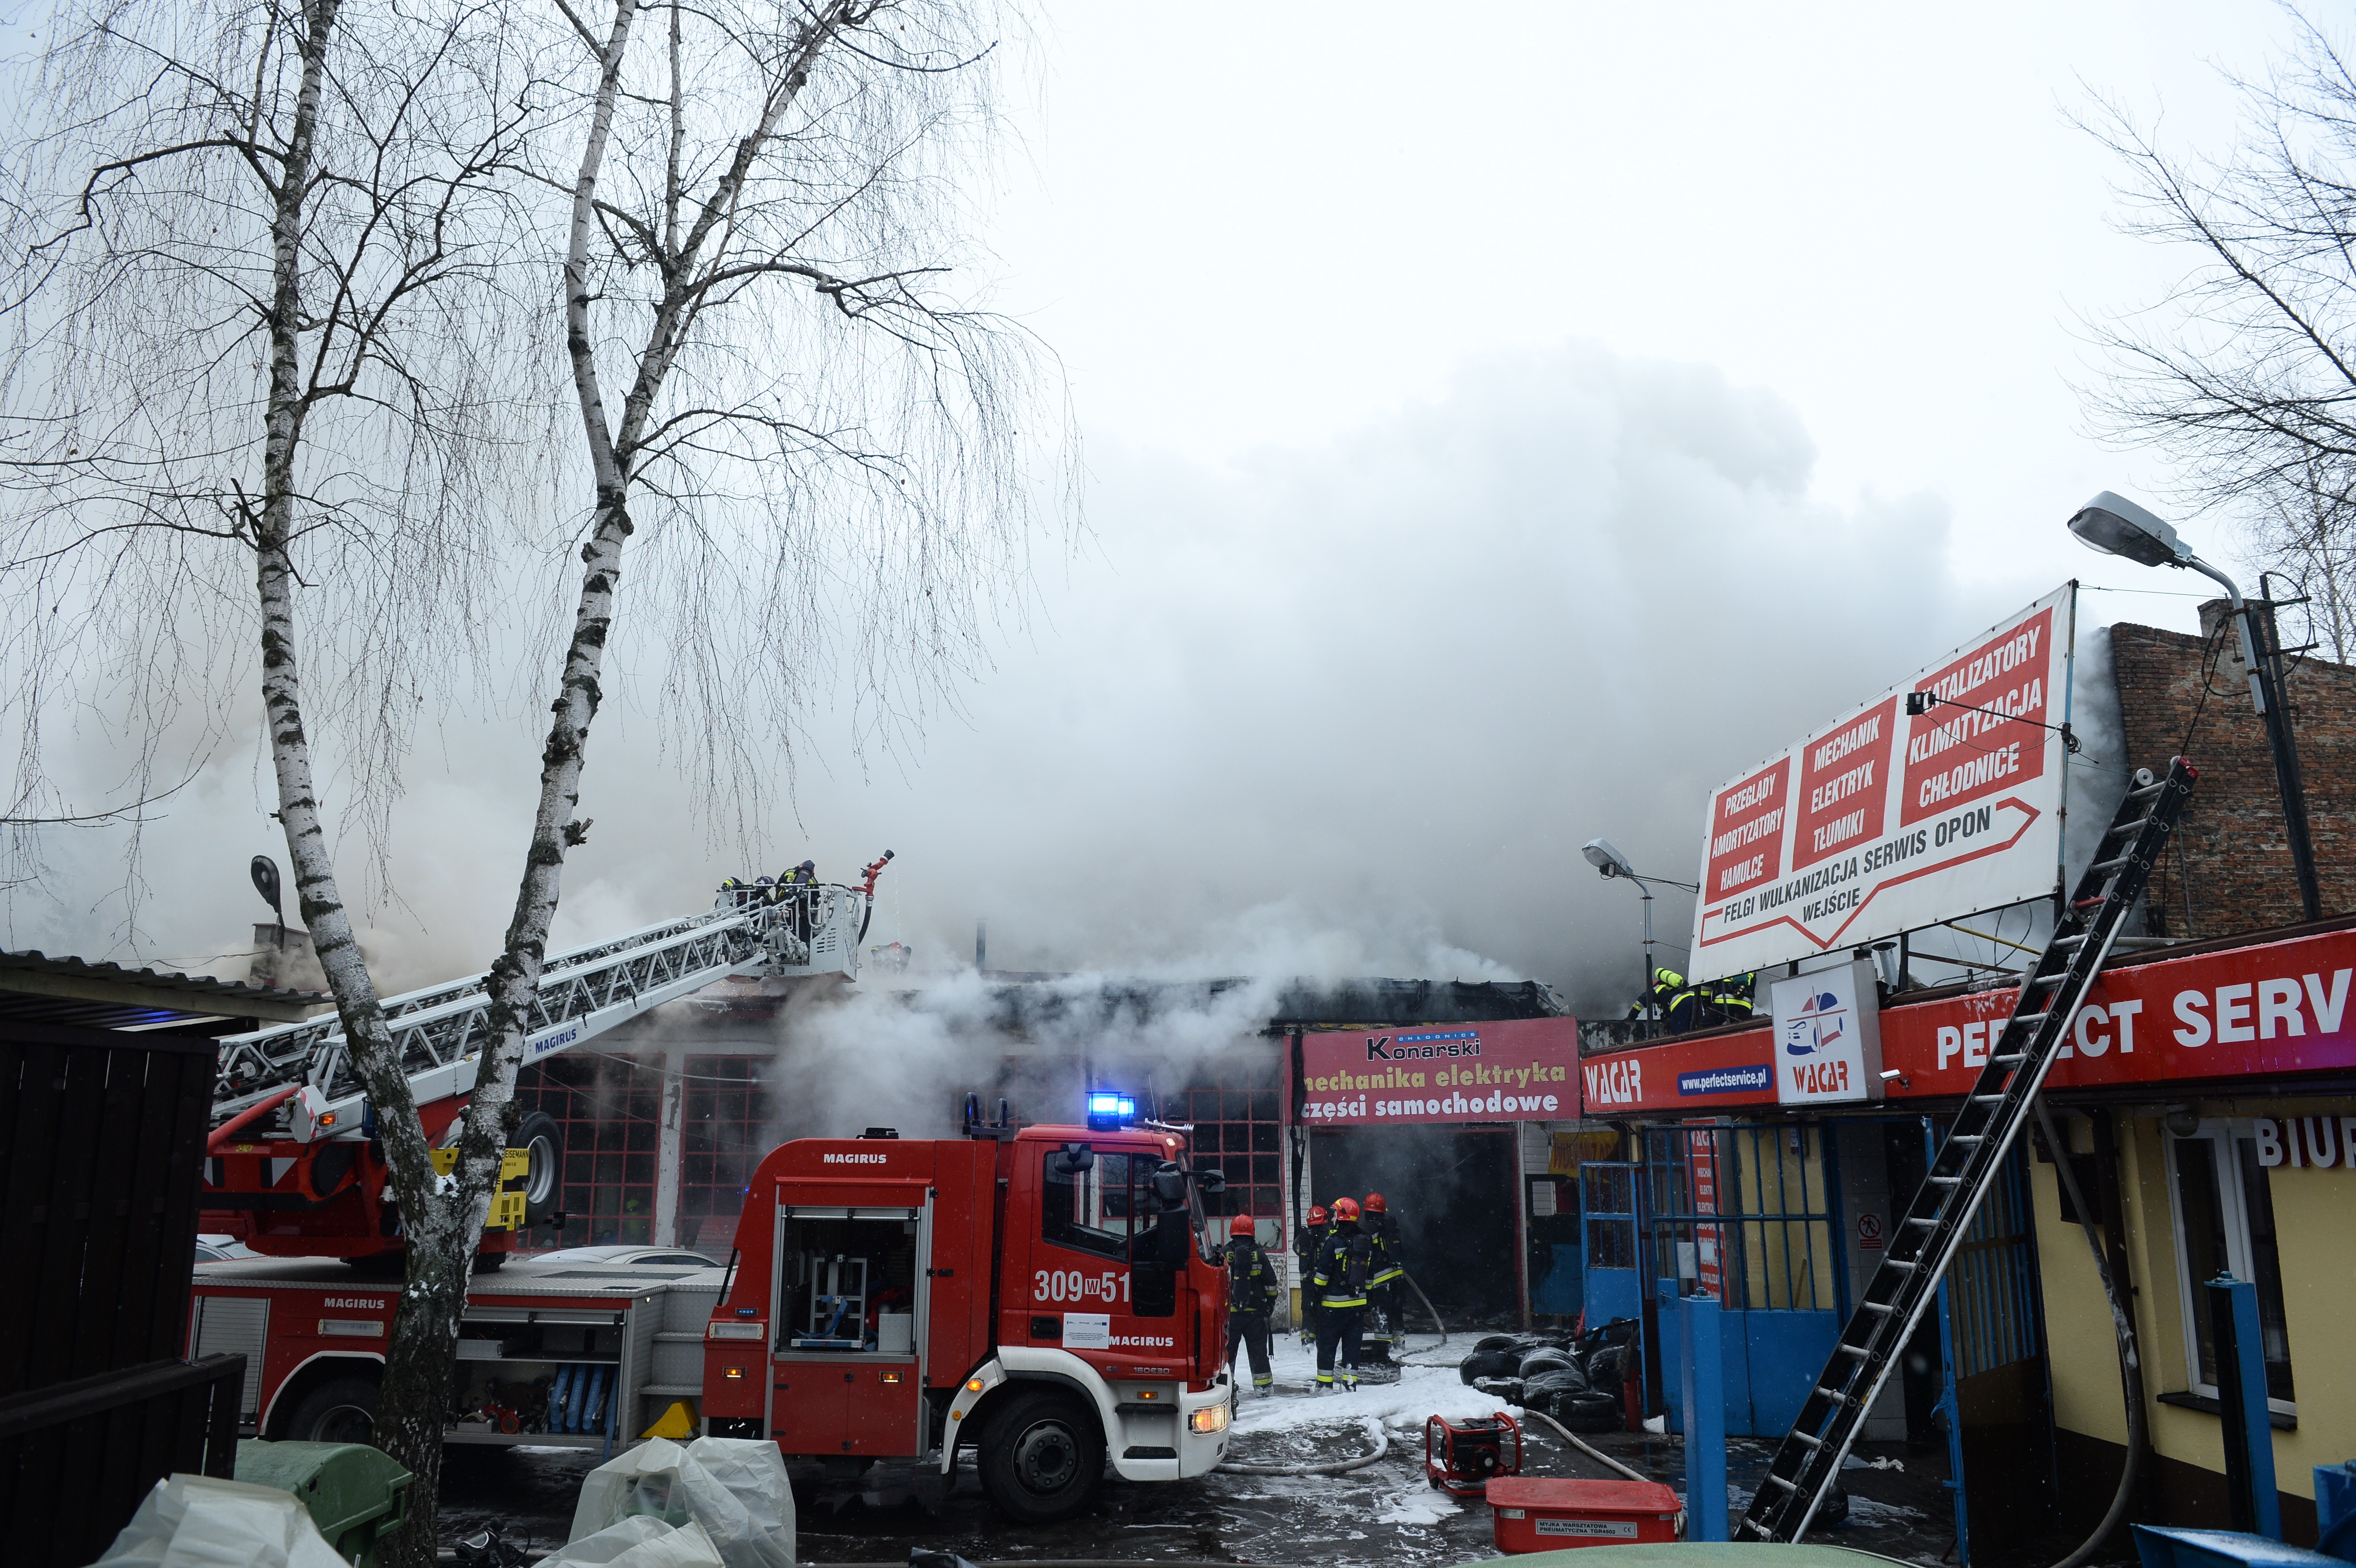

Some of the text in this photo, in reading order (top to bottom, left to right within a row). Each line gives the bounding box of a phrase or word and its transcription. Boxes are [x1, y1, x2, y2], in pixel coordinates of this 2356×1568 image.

[1909, 677, 2042, 766] KLIMATYZACJA
[1814, 714, 1881, 773] MECHANIK
[1811, 759, 1875, 814] ELEKTRYK
[1920, 741, 2020, 808] CHŁODNICE
[1725, 773, 1777, 818] PRZEGLĄDY
[1712, 806, 1784, 859] AMORTYZATORY
[1813, 808, 1865, 853] TŁUMIKI
[1721, 853, 1764, 891] HAMULCE
[1724, 806, 1991, 924] FELGI WULKANIZACJA SERWIS OPON
[1802, 887, 1860, 923] WEJŚCIE
[1398, 1032, 1475, 1041] CHŁODNICE
[1938, 968, 2353, 1070] PECT SERV
[535, 1029, 576, 1054] MAGIRUS
[1366, 1036, 1481, 1061] Konarski
[1435, 1060, 1566, 1089] elektryka
[1585, 1059, 1642, 1104] WACAR
[1682, 1068, 1766, 1091] www.perfectservice.pl
[1793, 1060, 1848, 1093] WACAR
[1301, 1090, 1559, 1122] części samochodowe
[505, 1150, 529, 1158] EISEMANN
[824, 1154, 886, 1164] MAGIRUS
[325, 1298, 384, 1309] MAGIRUS
[1109, 1336, 1174, 1347] MAGIRUS
